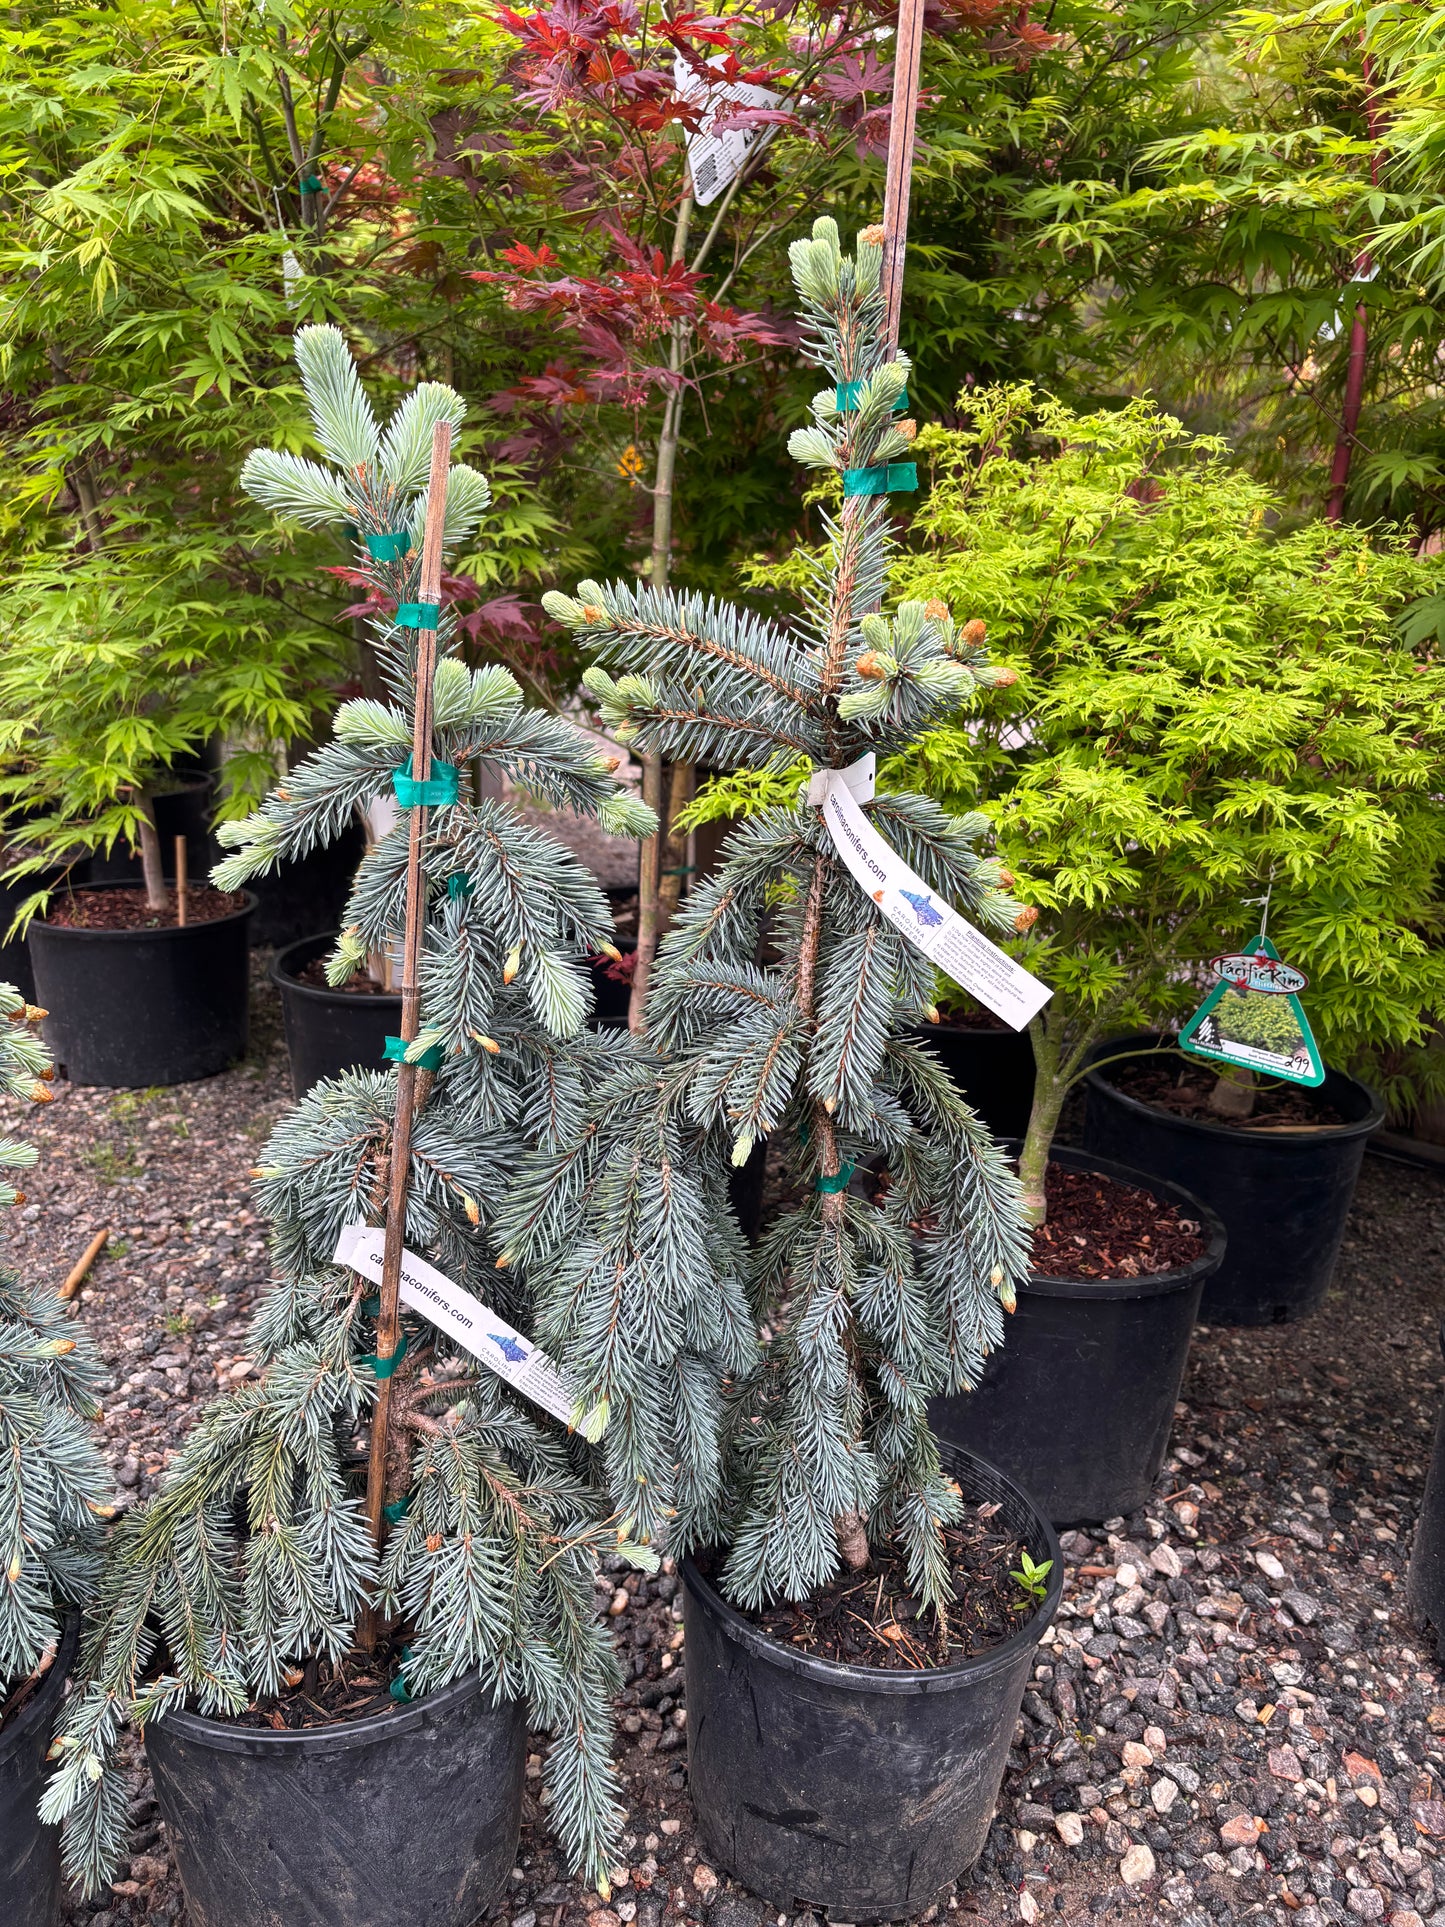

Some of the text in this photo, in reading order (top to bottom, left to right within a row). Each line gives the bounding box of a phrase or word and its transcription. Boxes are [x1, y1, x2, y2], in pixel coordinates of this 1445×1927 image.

[830, 793, 888, 883] carolinaconifers.com
[890, 913, 922, 945] CONIFERS
[893, 906, 925, 938] CAROLINA
[965, 930, 987, 949] Planting
[1219, 957, 1266, 983] Pacific
[1284, 1055, 1310, 1074] 299
[369, 1252, 474, 1329] carnaconifers.com
[478, 1352, 509, 1378] CONIFERS
[481, 1346, 513, 1372] CAROLINA
